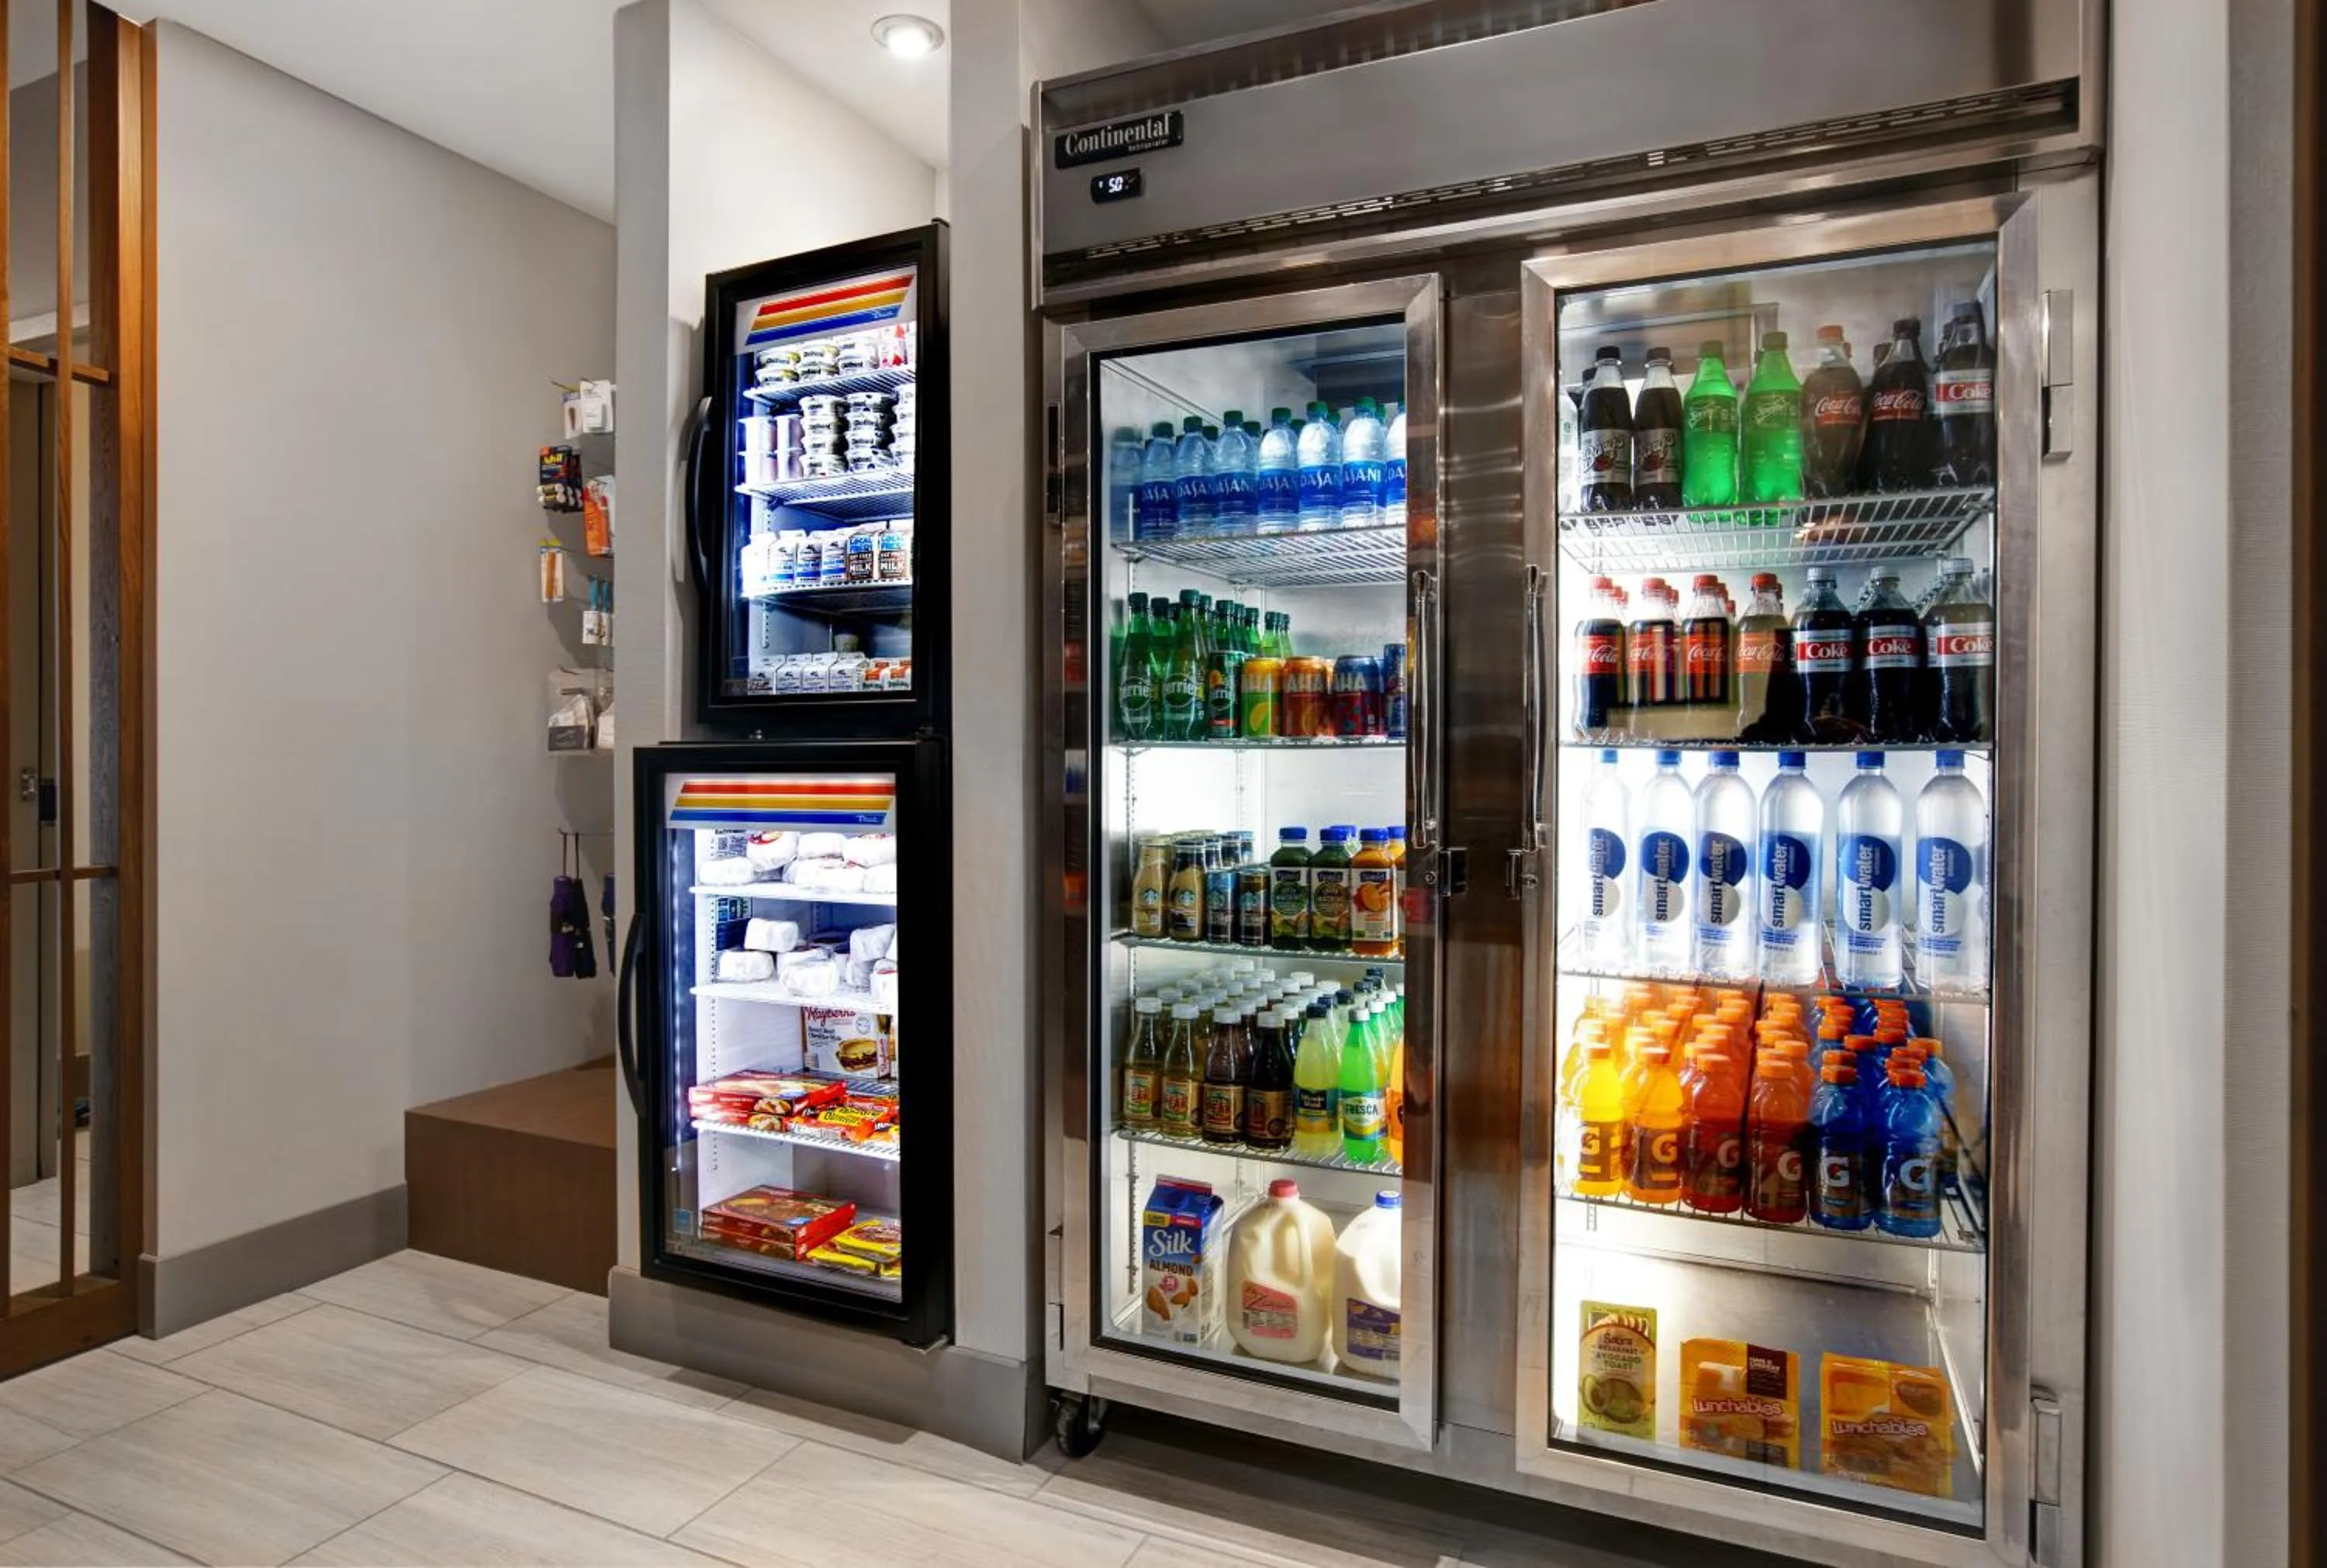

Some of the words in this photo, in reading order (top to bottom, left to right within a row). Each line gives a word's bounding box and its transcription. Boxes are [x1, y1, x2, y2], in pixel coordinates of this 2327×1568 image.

[1065, 113, 1170, 156] Continental
[1343, 468, 1381, 485] ASANI
[1807, 643, 1848, 658] Coke
[1868, 639, 1911, 654] Coke
[1950, 637, 1993, 653] Coke
[1287, 673, 1324, 692] AHA
[1655, 838, 1671, 921] smartwater
[1710, 840, 1726, 924] smartwater
[1772, 842, 1787, 928] smartwater
[1856, 844, 1873, 931] smartwater
[1929, 845, 1946, 934] smartwater
[1345, 1103, 1379, 1116] FRESCA
[1651, 1134, 1678, 1164] G
[1717, 1139, 1740, 1169] G
[1777, 1151, 1802, 1181] G
[1820, 1156, 1850, 1188] G
[1900, 1159, 1932, 1191] G
[1148, 1228, 1195, 1258] Silk
[1149, 1259, 1195, 1277] ALMOND
[1693, 1397, 1782, 1416] Lunchables
[1832, 1419, 1928, 1437] Lunchables
